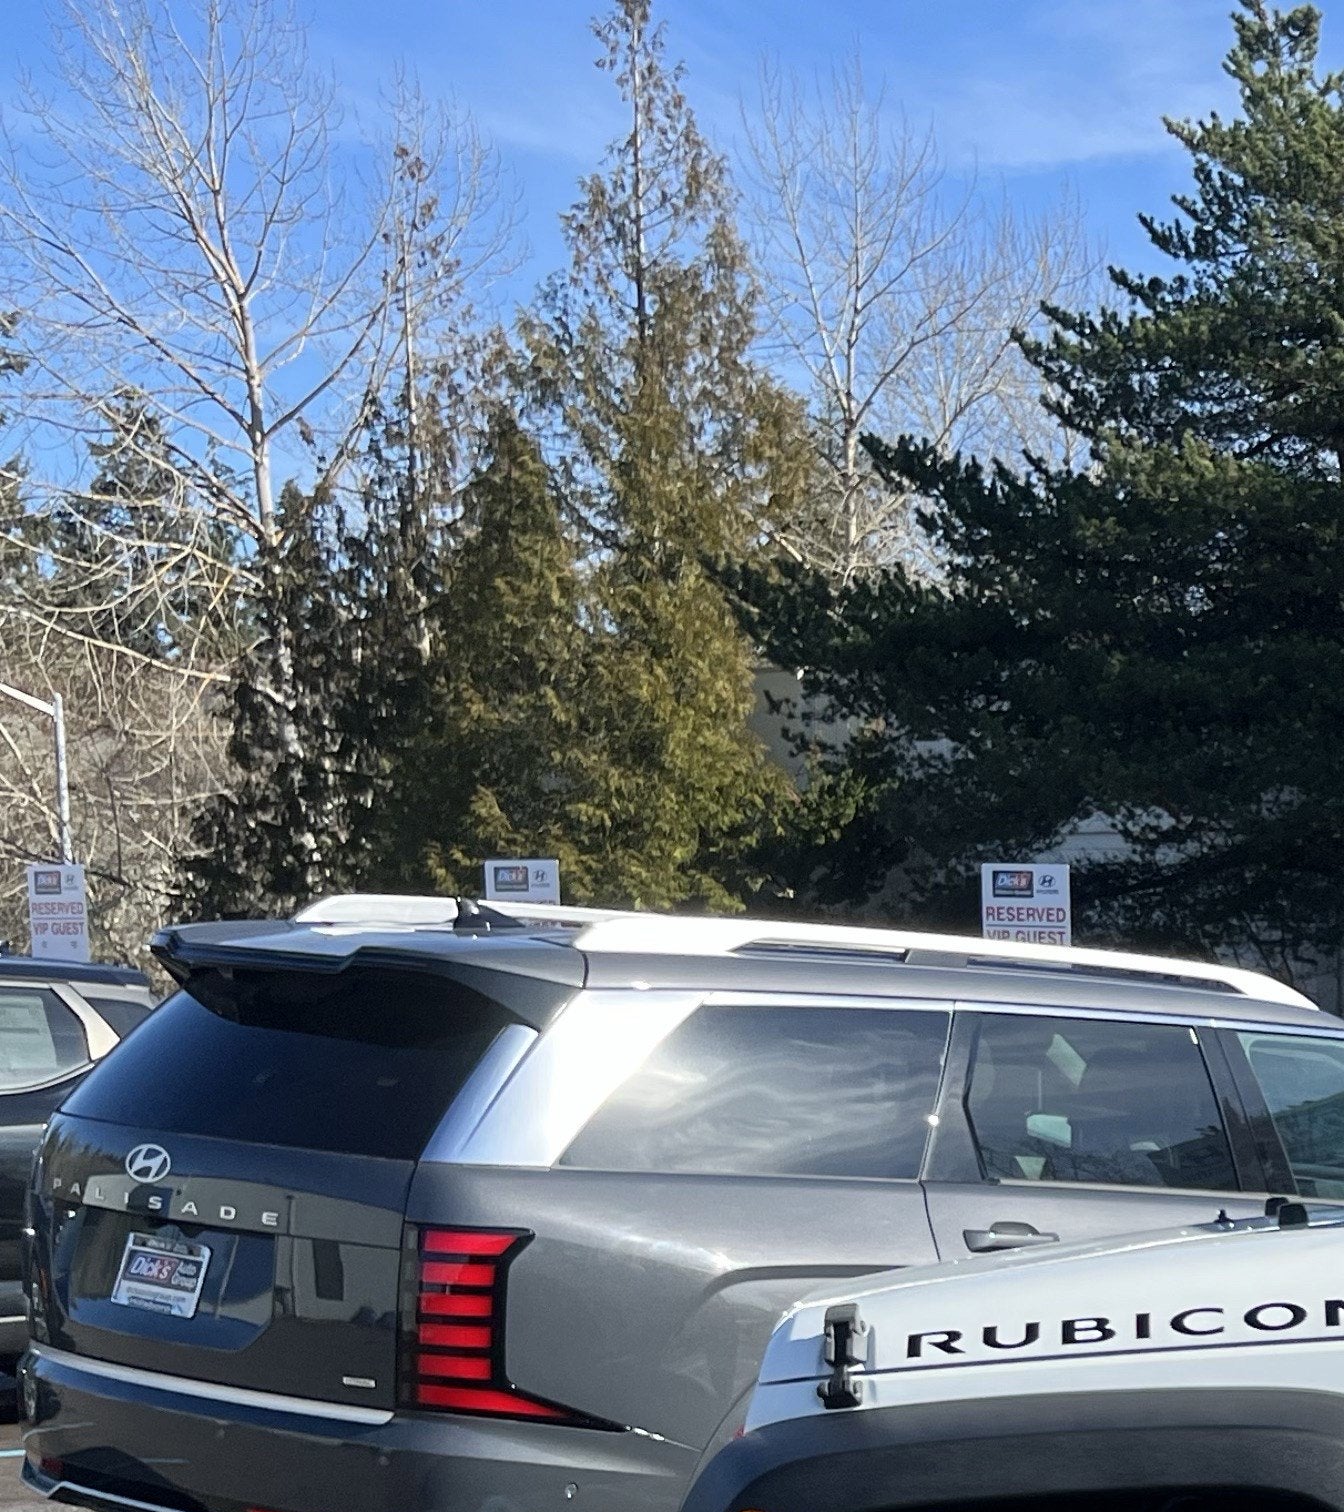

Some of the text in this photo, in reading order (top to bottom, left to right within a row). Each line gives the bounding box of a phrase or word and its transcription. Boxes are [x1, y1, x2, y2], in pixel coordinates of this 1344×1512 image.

[31, 902, 83, 915] RESERVED
[986, 906, 1066, 923] RESERVED
[33, 922, 84, 935] VIP GUEST
[986, 929, 1065, 945] VIP GUEST
[53, 1177, 279, 1227] PALISADE
